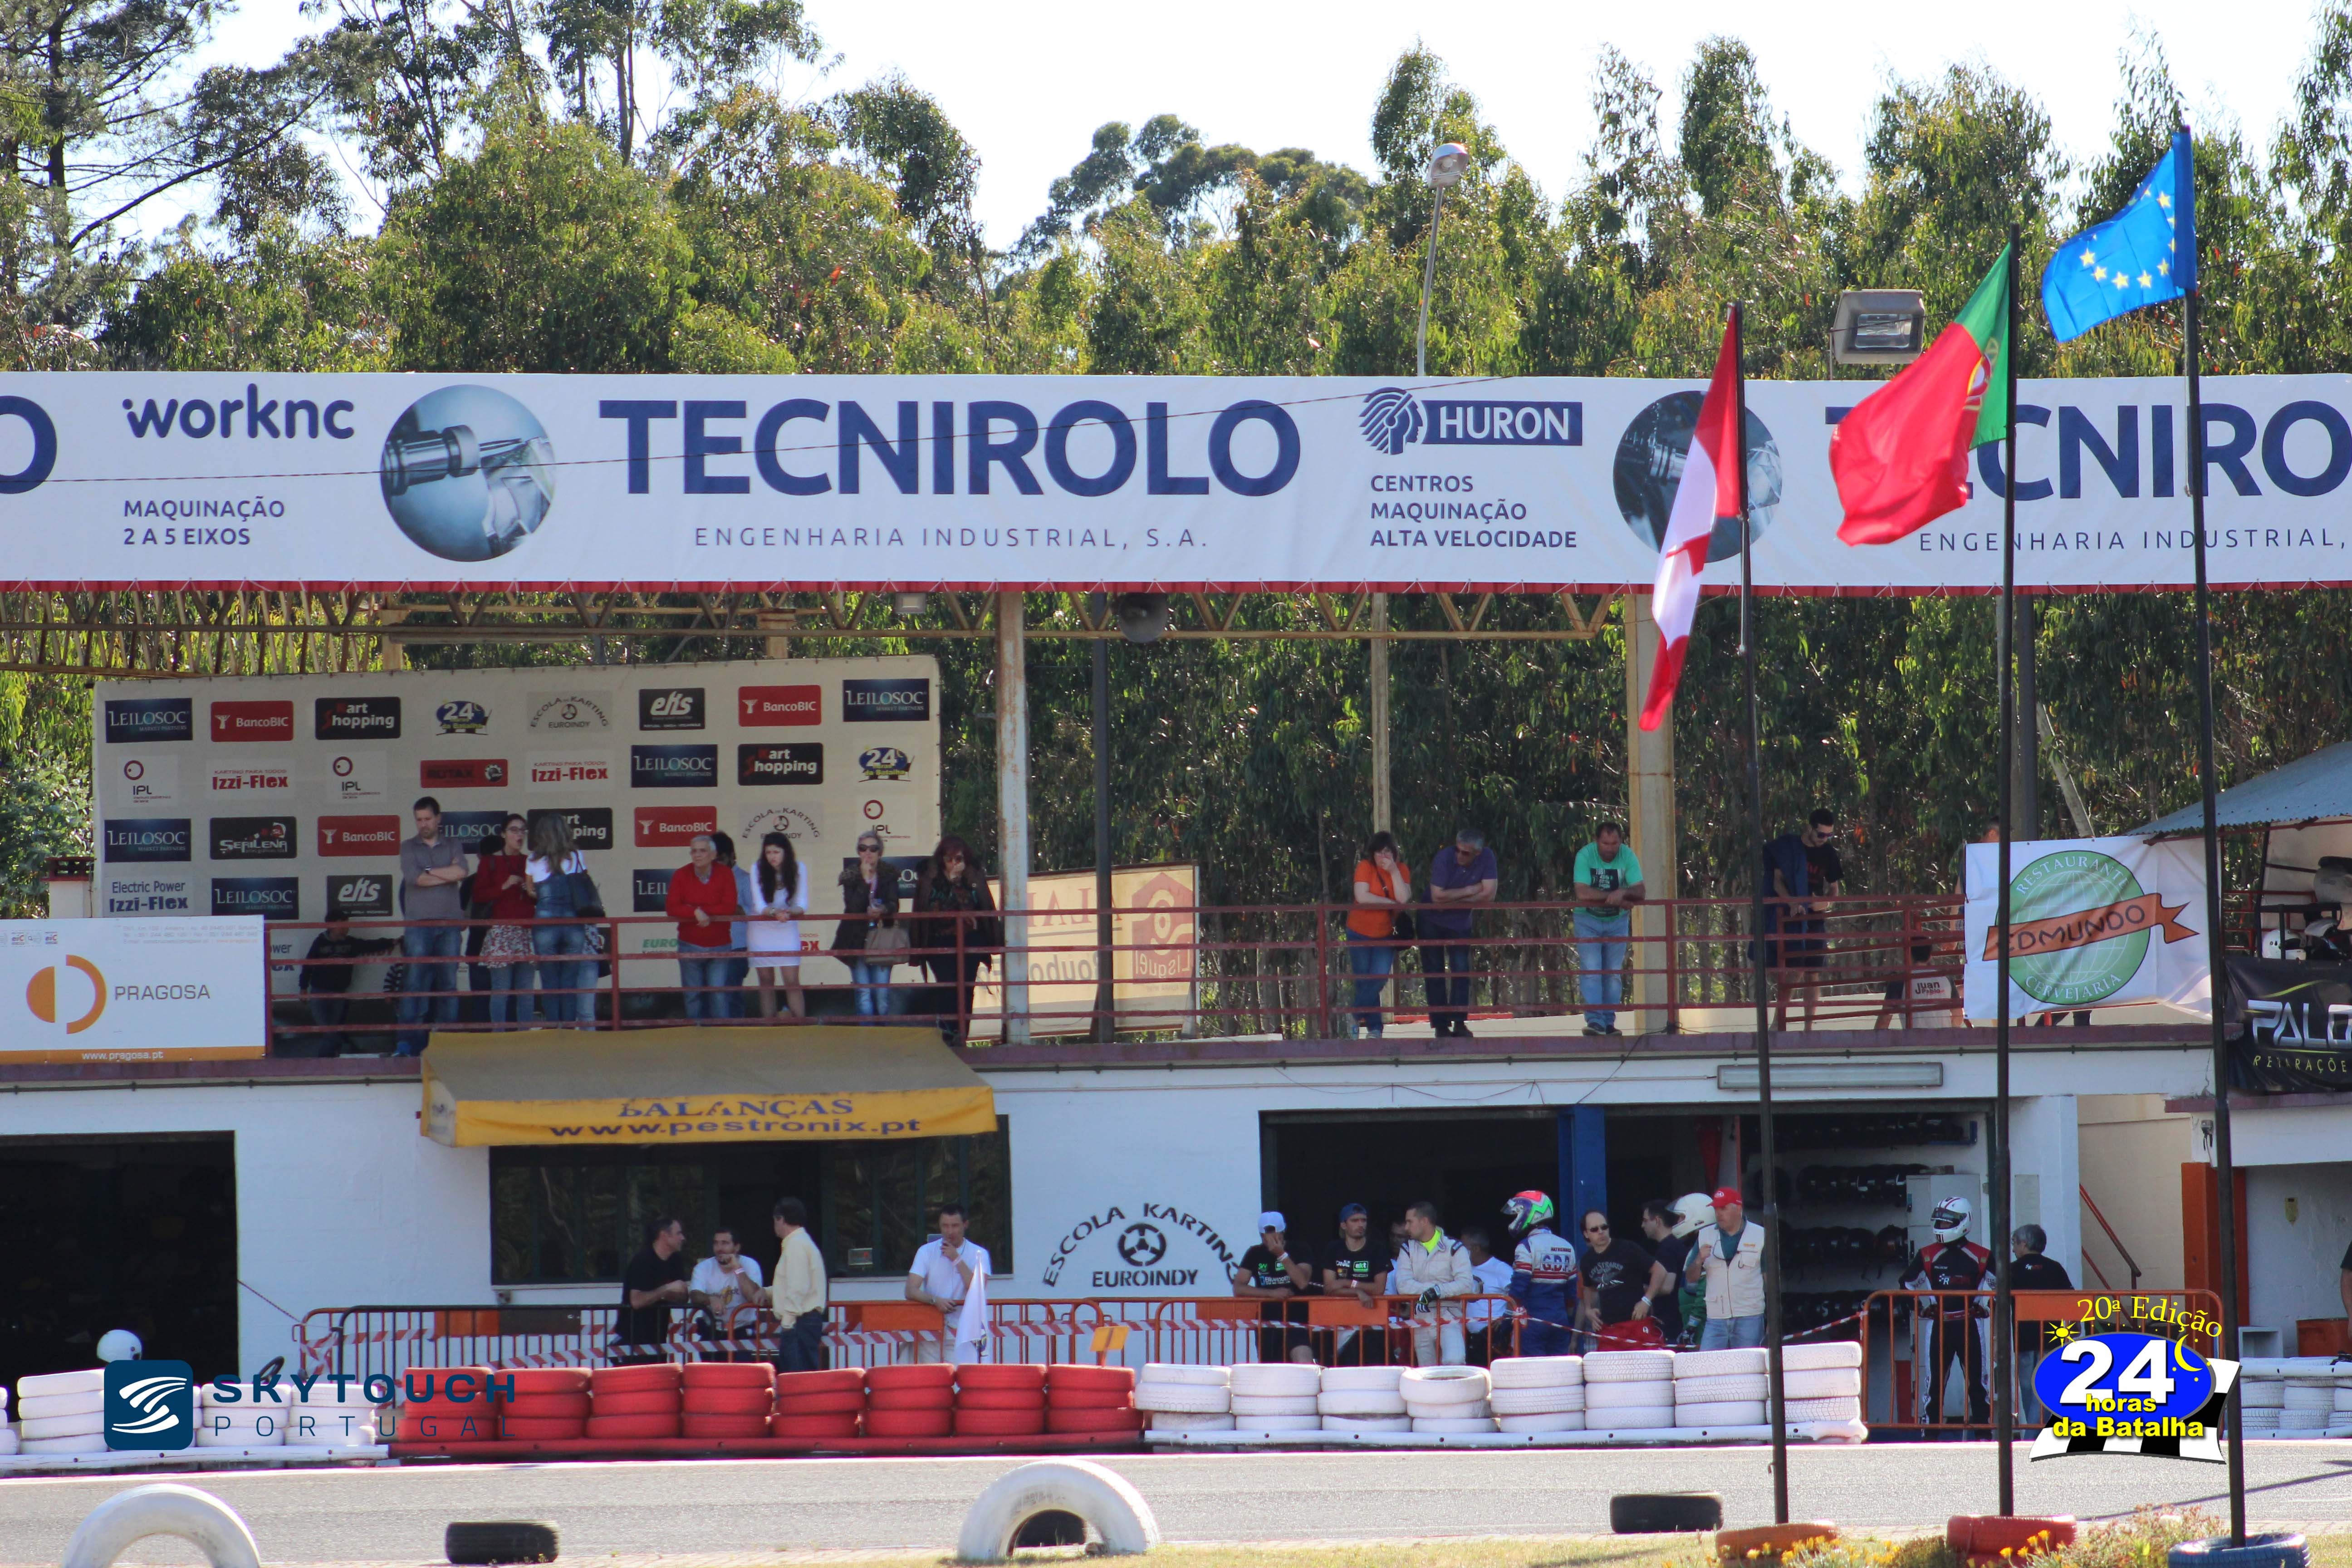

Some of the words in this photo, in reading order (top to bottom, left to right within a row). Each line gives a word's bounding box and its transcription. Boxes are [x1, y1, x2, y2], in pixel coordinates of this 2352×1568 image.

[122, 383, 354, 439] worknc
[1440, 406, 1569, 440] HURON
[599, 398, 1301, 497] TECNIROLO
[1825, 400, 2352, 501] CNIRO
[1371, 475, 1474, 492] CENTROS
[124, 495, 285, 522] MAQUINAÇÃO
[1371, 498, 1527, 522] MAQUINAÇÃO
[124, 528, 135, 545] 2
[142, 528, 158, 545] A
[166, 528, 176, 545] 5
[184, 528, 251, 545] EIXOS
[696, 527, 905, 548] ENGENHARIA
[923, 527, 1128, 551] INDUSTRIAL,
[1147, 526, 1208, 548] S.A.
[1370, 530, 1427, 547] ALTA
[1434, 530, 1577, 548] VELOCIDADE
[1921, 531, 2124, 551] ENGENHARIA
[2145, 528, 2346, 550] INDUSTRIAL,
[845, 690, 924, 705] LEILOSOC
[443, 703, 475, 721] 24
[530, 697, 562, 728] ESCOLA
[570, 696, 609, 727] KARTING
[763, 701, 817, 712] BancoBIC
[108, 711, 186, 726] LEILOSOC
[236, 717, 289, 728] BancoBIC
[633, 755, 712, 771] LEILOSOC
[866, 749, 897, 767] 24
[213, 775, 289, 790] Izzi-Flex
[531, 767, 608, 783] Izzi-Flex
[132, 785, 152, 795] IPL
[342, 781, 362, 791] IPL
[659, 822, 712, 832] BancoBIC
[742, 808, 774, 838] ESCOLA
[782, 807, 821, 838] KARTING
[108, 831, 186, 845] LEILOSOC
[343, 832, 396, 842] BancoBIC
[573, 826, 607, 839] ping
[2016, 856, 2130, 895] RESTAURANTE
[112, 881, 150, 893] Electric
[154, 880, 186, 892] Power
[636, 880, 668, 894] LEIL
[109, 896, 189, 912] Izzi-Flex
[215, 889, 293, 904] LEILOSOC
[114, 984, 211, 1000] PRAGOSA
[1915, 981, 1940, 995] Juan
[2025, 974, 2122, 1002] CERVEJARIA
[82, 1050, 163, 1061] www.pragosa.pt
[549, 1116, 922, 1137] www.pestronix.pt
[1043, 1206, 1126, 1288] ESCOLA
[1092, 1269, 1198, 1287] EUROINDY
